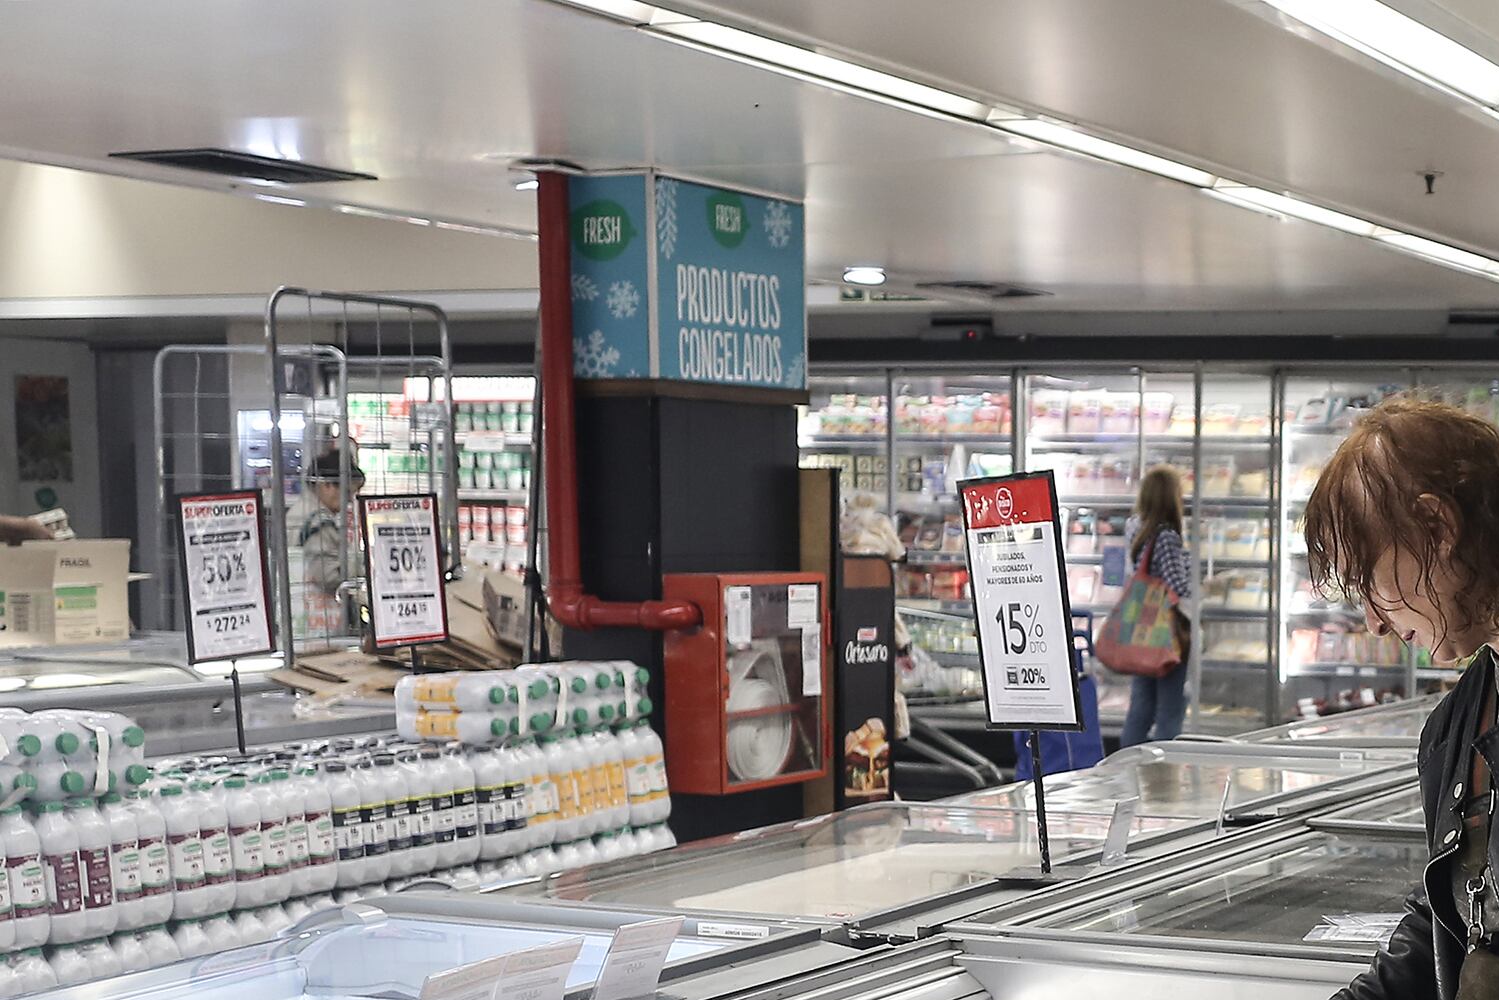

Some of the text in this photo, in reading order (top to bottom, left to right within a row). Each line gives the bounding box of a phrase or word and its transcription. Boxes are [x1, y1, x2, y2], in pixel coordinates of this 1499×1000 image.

[583, 216, 621, 244] FRESH
[716, 204, 741, 233] FRESH
[676, 264, 780, 330] PRODUCTOS
[679, 327, 783, 384] CONGELADOS
[1026, 573, 1044, 584] AÑOS
[1021, 668, 1046, 684] 20%
